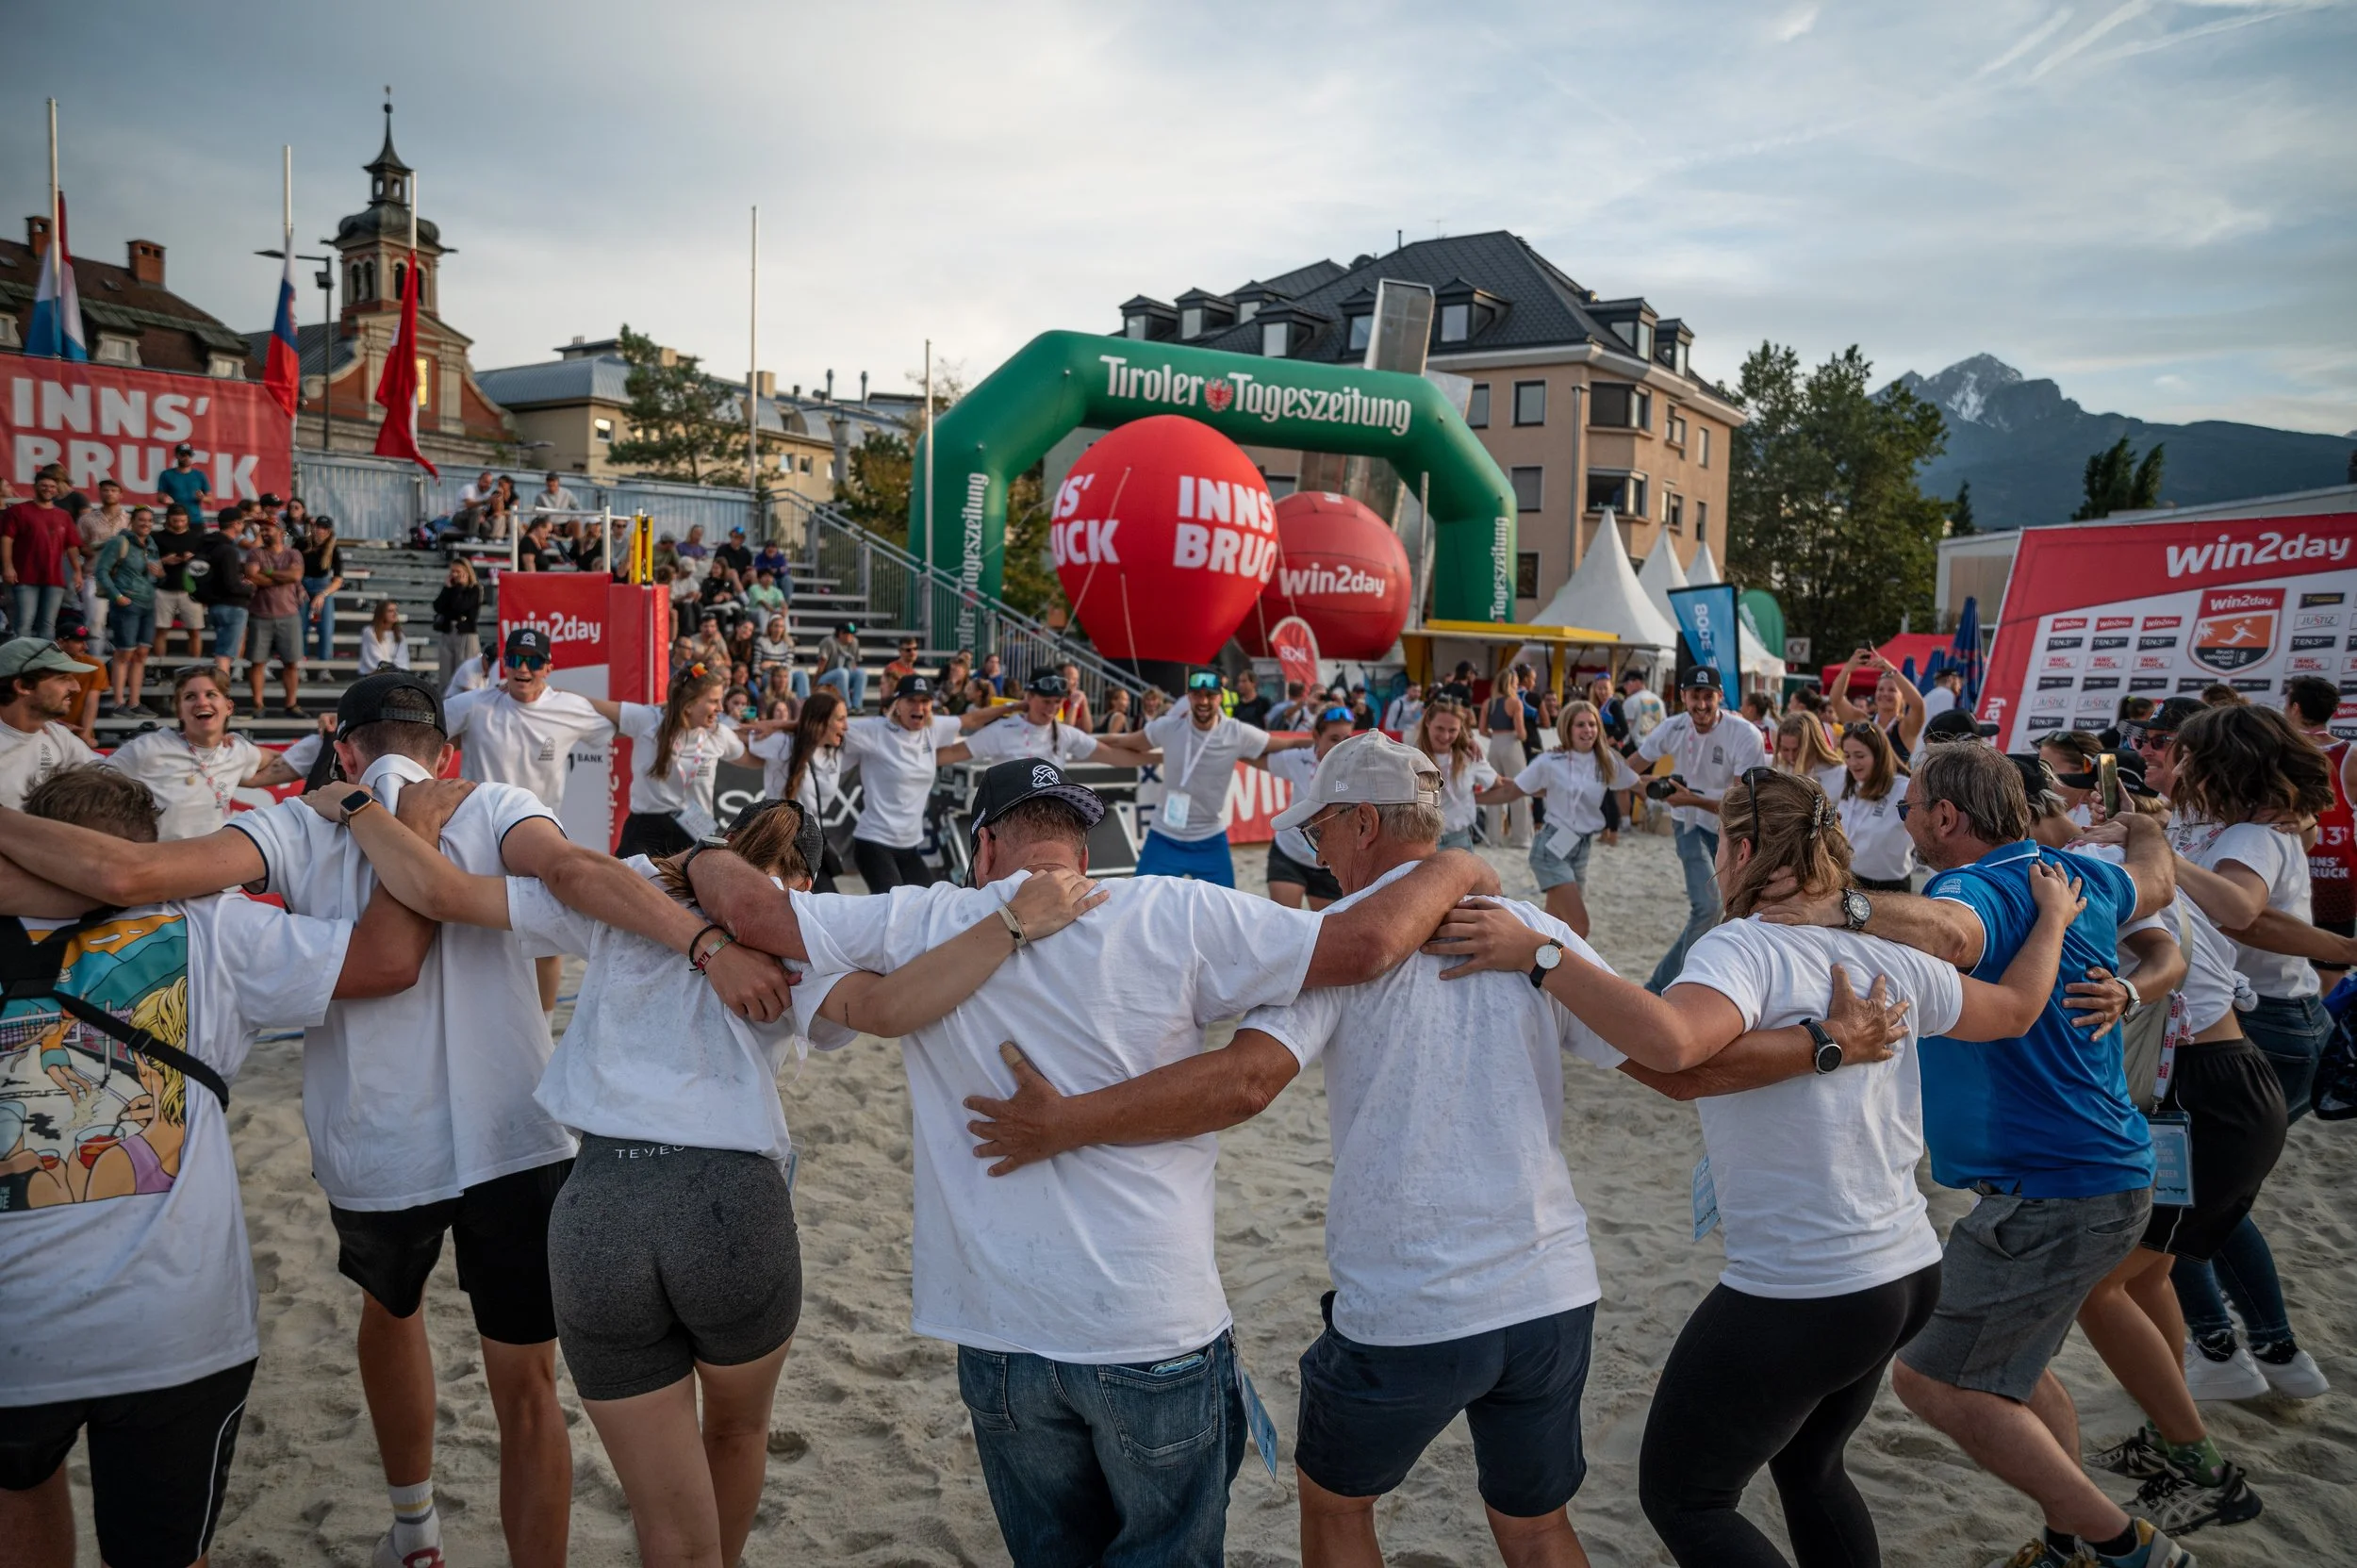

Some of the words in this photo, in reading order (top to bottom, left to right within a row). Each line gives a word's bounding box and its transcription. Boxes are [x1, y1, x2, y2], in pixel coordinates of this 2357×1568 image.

[11, 377, 210, 442] INNS'
[1099, 355, 1204, 405] Tiroler
[1228, 372, 1411, 436] Tageszeitung
[13, 435, 259, 500] BRUK
[1278, 563, 1386, 598] win2day
[1490, 517, 1509, 620] Tageszeitung
[2166, 532, 2351, 578] win2day
[2210, 595, 2274, 611] win2day
[578, 753, 603, 763] BANK
